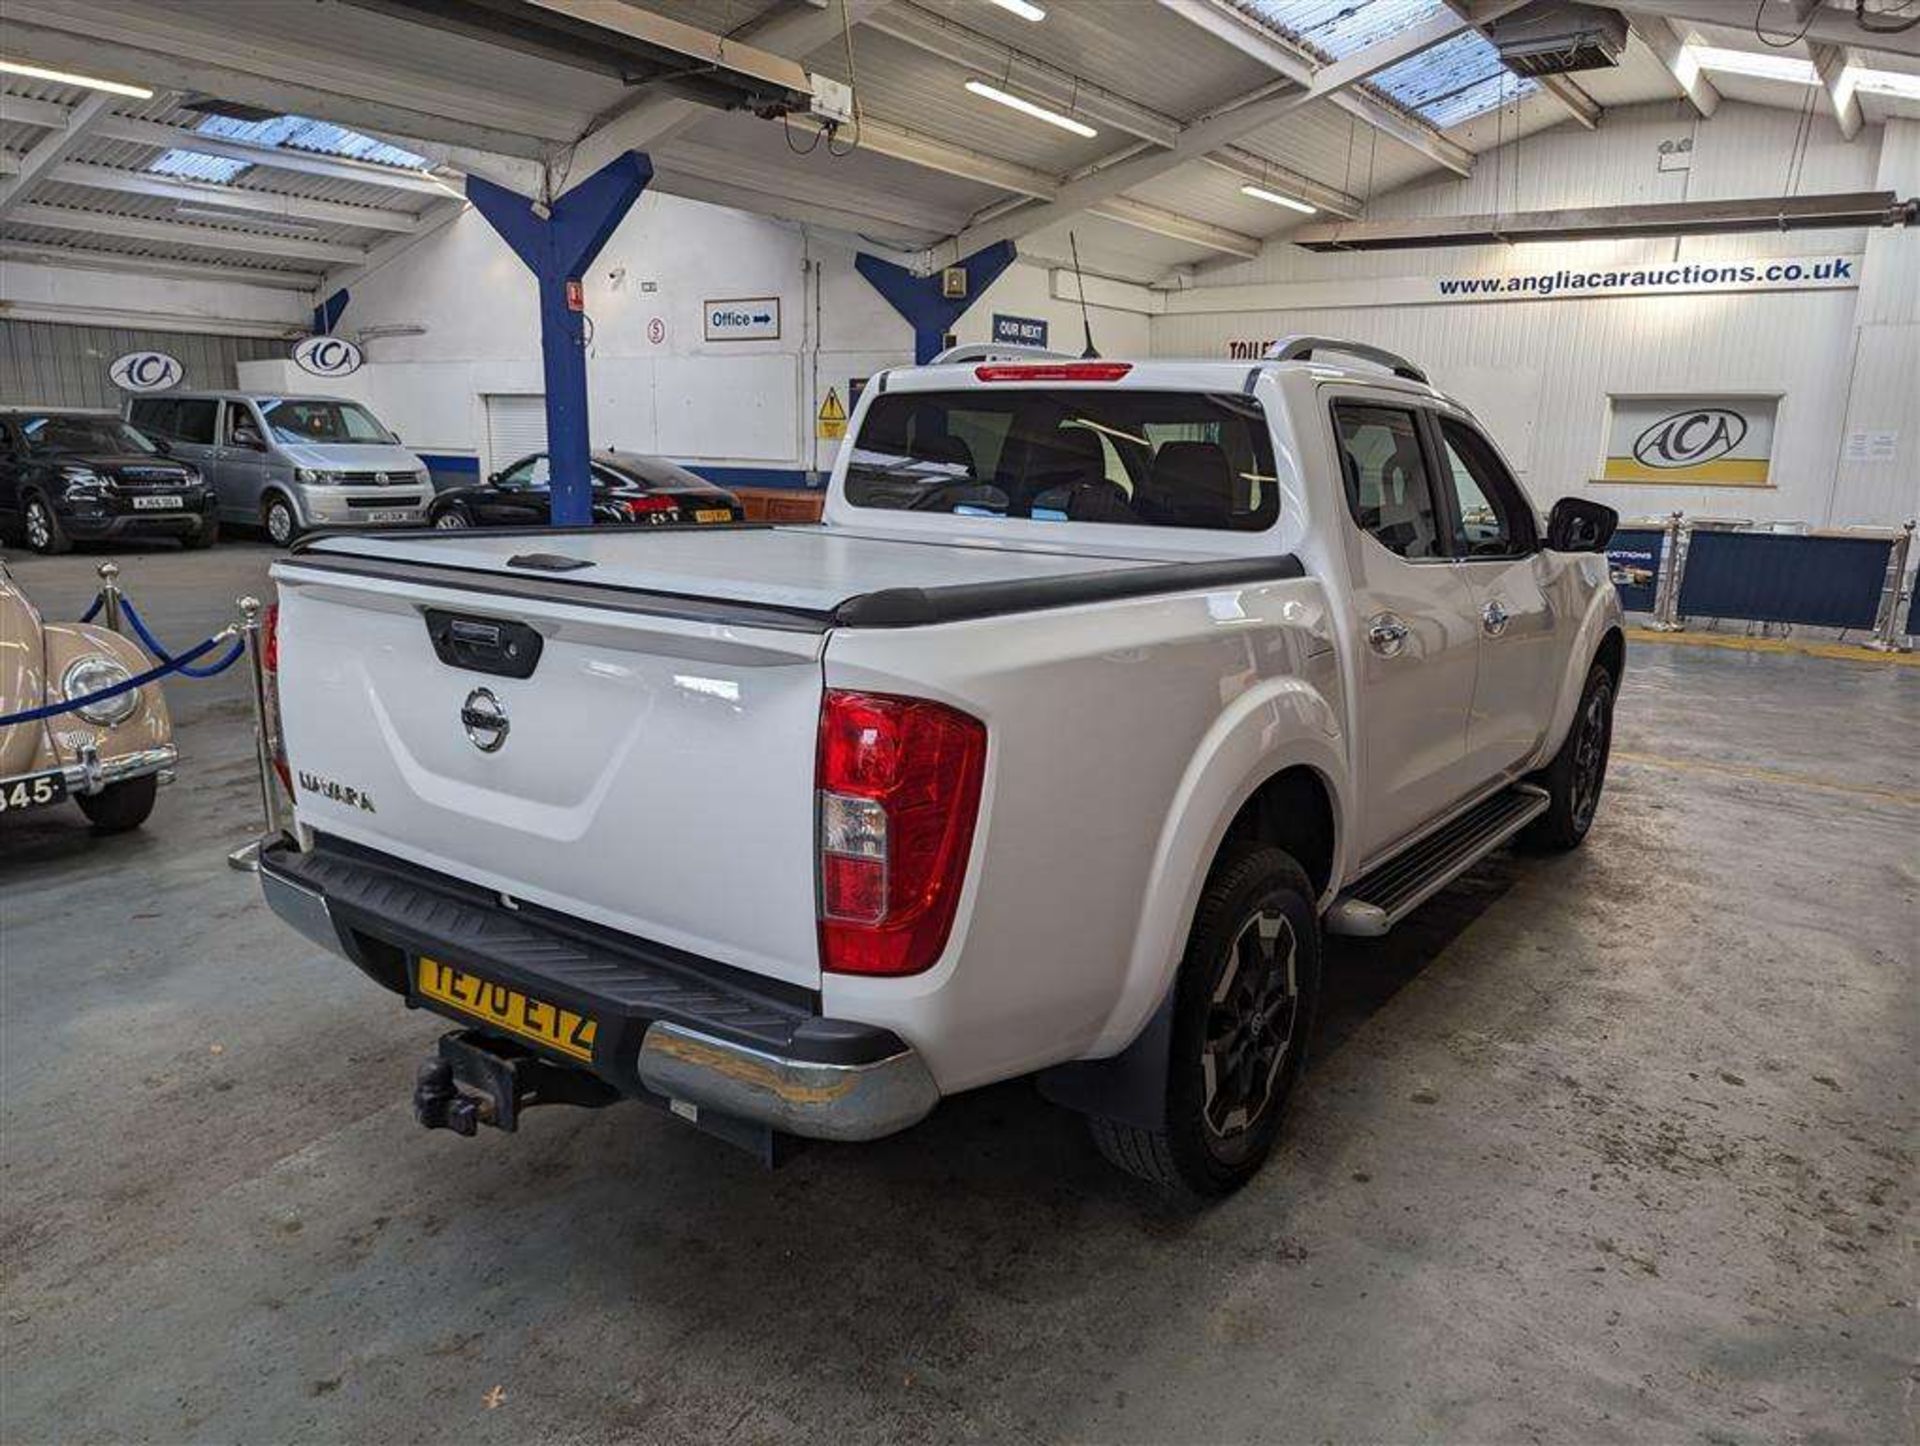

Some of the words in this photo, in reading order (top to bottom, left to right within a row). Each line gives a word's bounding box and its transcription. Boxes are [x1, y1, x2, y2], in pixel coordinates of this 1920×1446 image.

[1440, 258, 1852, 295] www.angliacarauctions.co.uk
[713, 312, 750, 327] Office
[999, 321, 1019, 336] OUR
[1021, 325, 1042, 339] NEXT
[1229, 340, 1278, 360] TOILE
[1638, 413, 1735, 462] ACA
